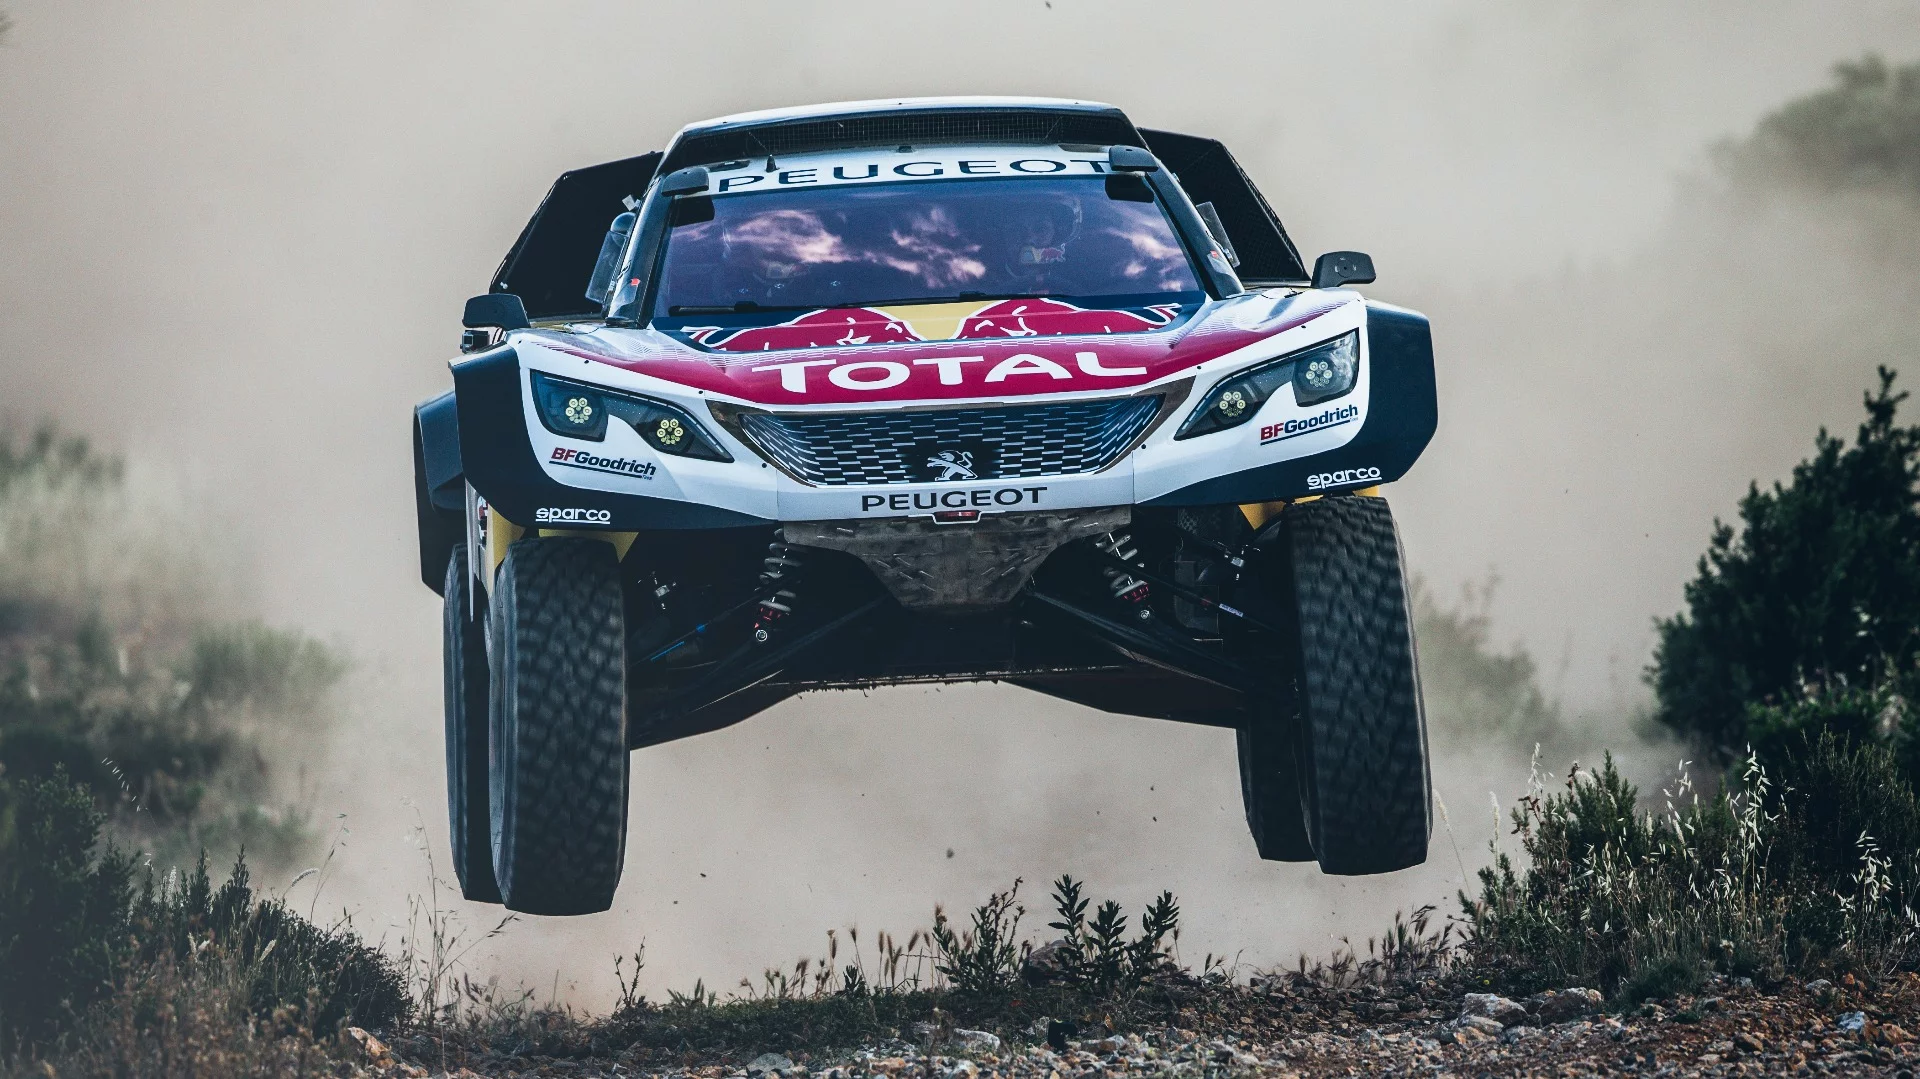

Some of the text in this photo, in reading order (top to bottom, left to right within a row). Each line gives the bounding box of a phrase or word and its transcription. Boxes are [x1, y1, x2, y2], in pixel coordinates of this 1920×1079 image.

[718, 158, 1111, 193] PEUGEOT
[751, 351, 1148, 394] TOTAL
[1260, 404, 1359, 441] BFGoodrich
[550, 446, 657, 476] BFGoodrich
[1306, 466, 1382, 490] sparco
[861, 486, 1048, 512] PEUGEOT
[535, 507, 612, 524] sparco
